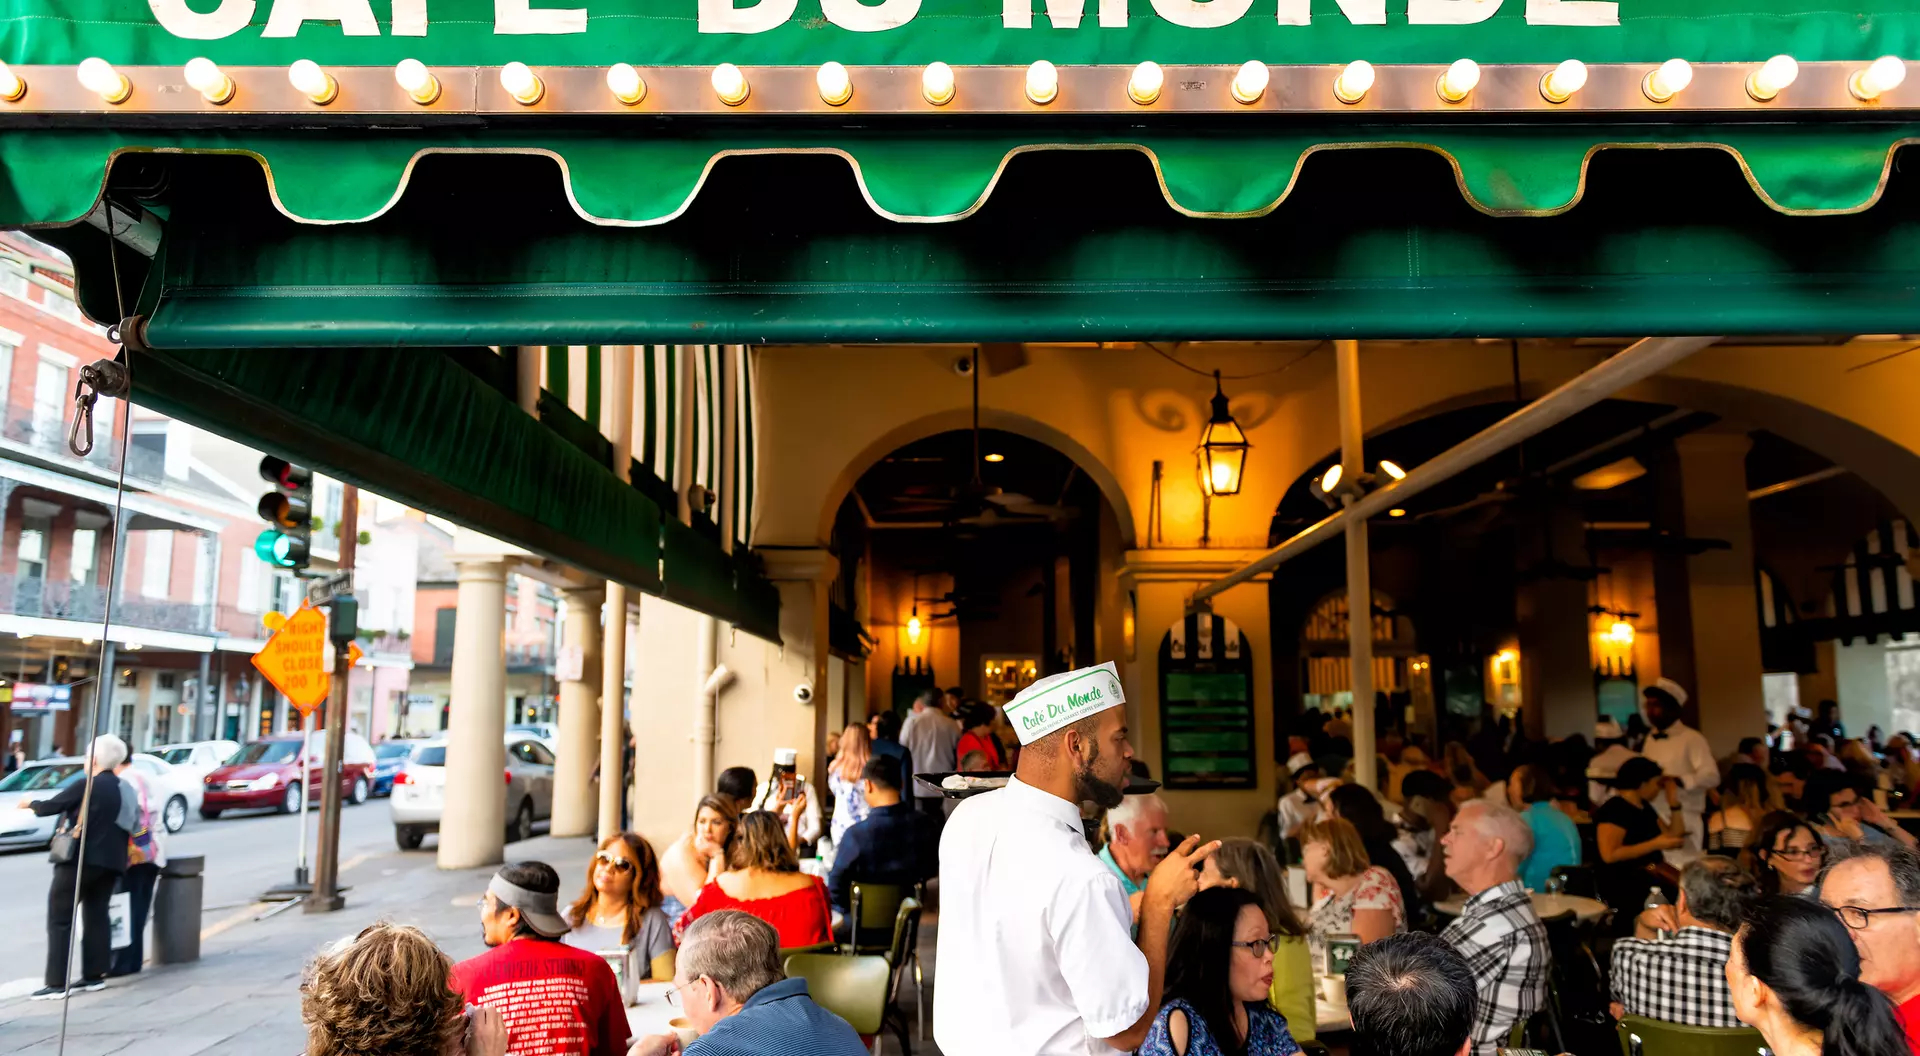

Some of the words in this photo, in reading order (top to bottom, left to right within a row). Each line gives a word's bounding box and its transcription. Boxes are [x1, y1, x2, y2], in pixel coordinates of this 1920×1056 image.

[290, 622, 325, 636] RIGHT
[275, 638, 325, 656] SHOULD
[282, 656, 321, 673] CLOSE
[1022, 710, 1046, 730] Café
[1046, 704, 1066, 718] Du
[1067, 686, 1103, 710] Monde
[477, 991, 507, 1003] BANNERS
[507, 989, 517, 997] OF
[517, 987, 530, 995] RED
[545, 984, 566, 992] WHITE
[484, 982, 511, 994] VARSITY
[512, 980, 532, 989] FIGHT
[546, 977, 566, 985] SANTA
[509, 996, 524, 1004] HOW
[525, 993, 546, 1002] GREAT
[547, 991, 564, 999] YOUR
[508, 1003, 530, 1013] MOTTO
[517, 1033, 530, 1041] AND
